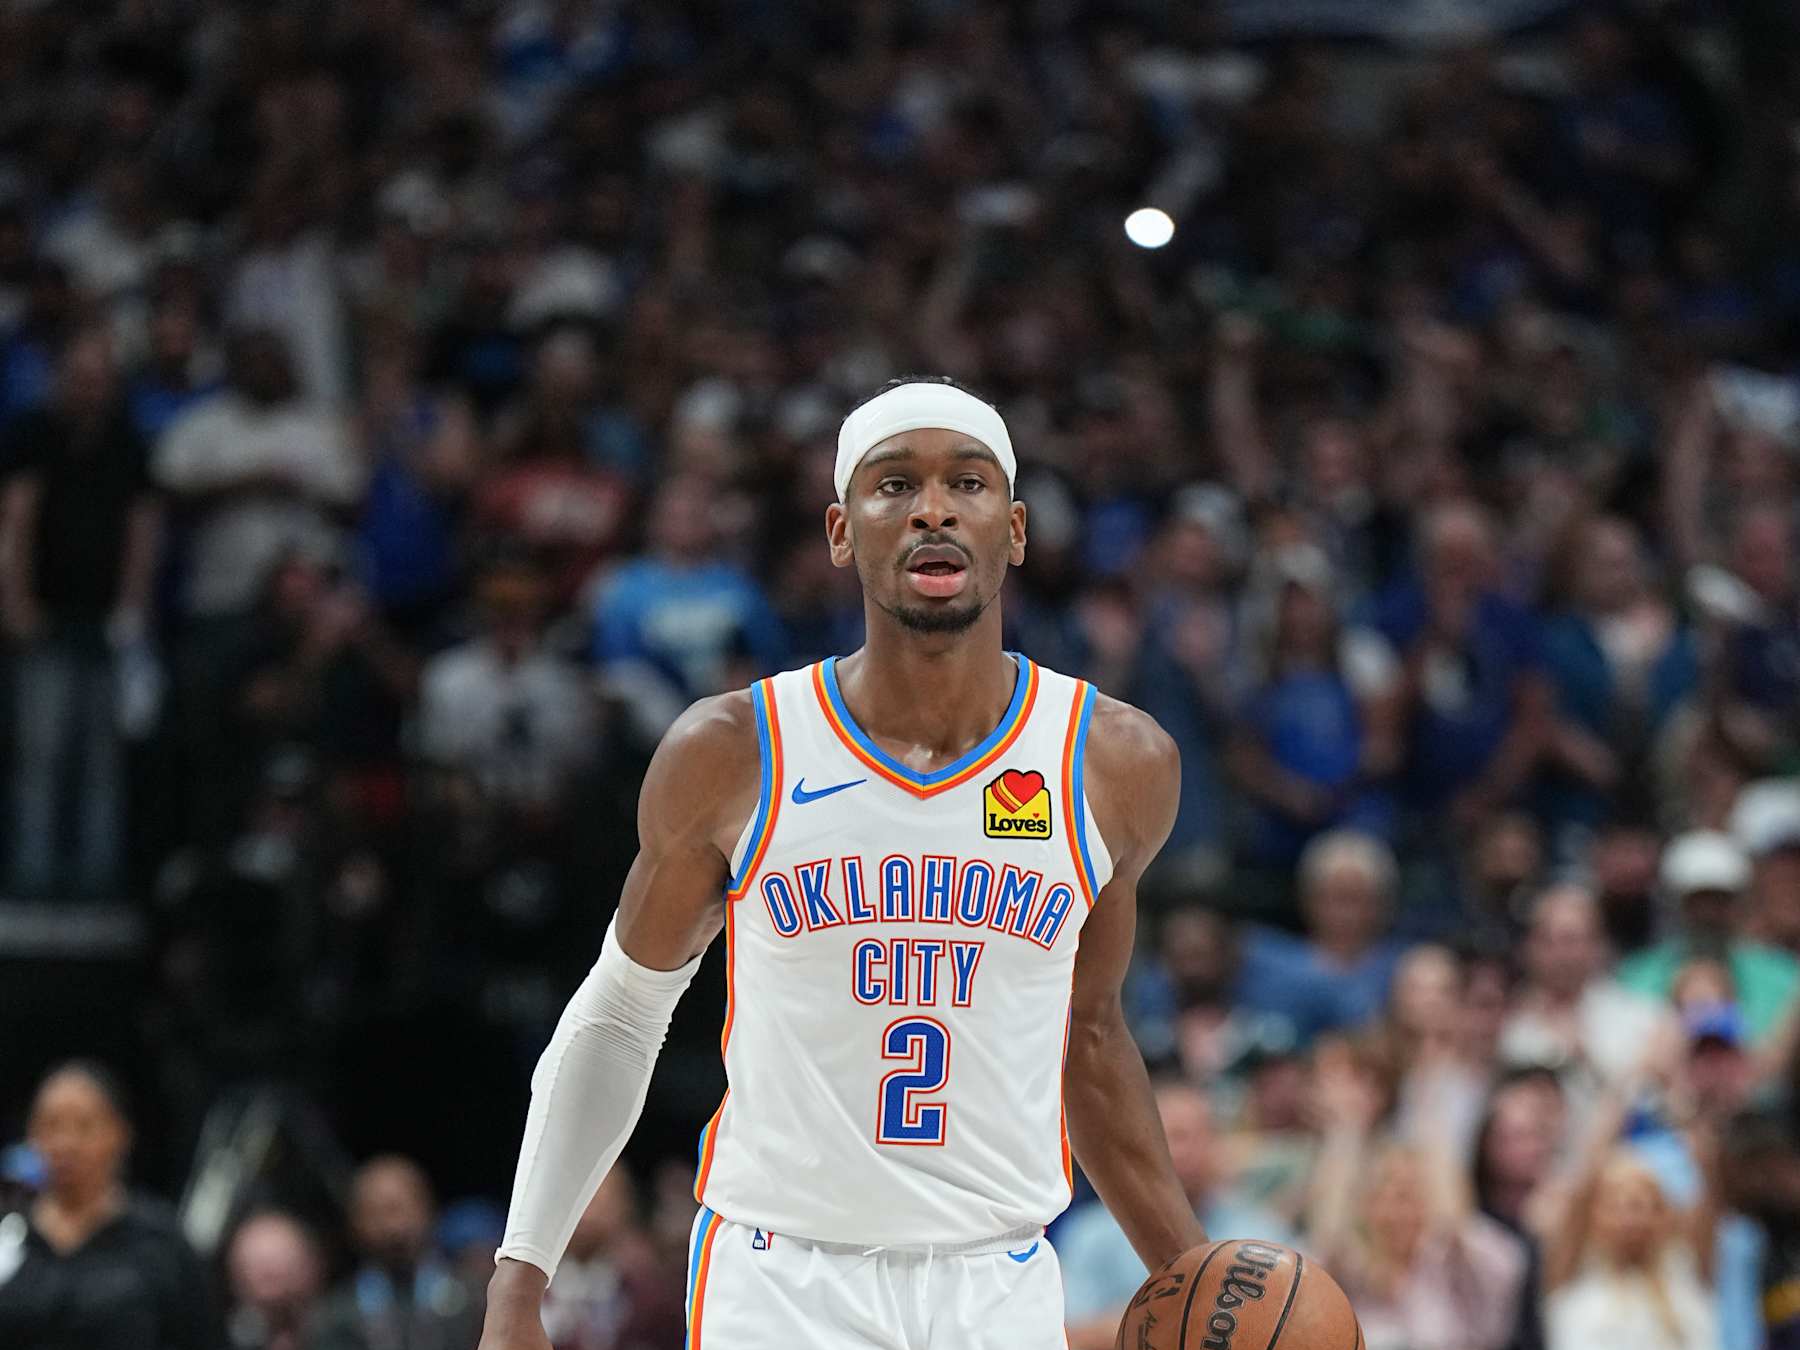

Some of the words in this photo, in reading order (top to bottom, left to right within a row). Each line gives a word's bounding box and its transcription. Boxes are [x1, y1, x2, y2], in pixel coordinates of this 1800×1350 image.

[761, 855, 1075, 950] OKLAHOMA
[853, 938, 985, 1007] CITY
[876, 1015, 951, 1146] 2
